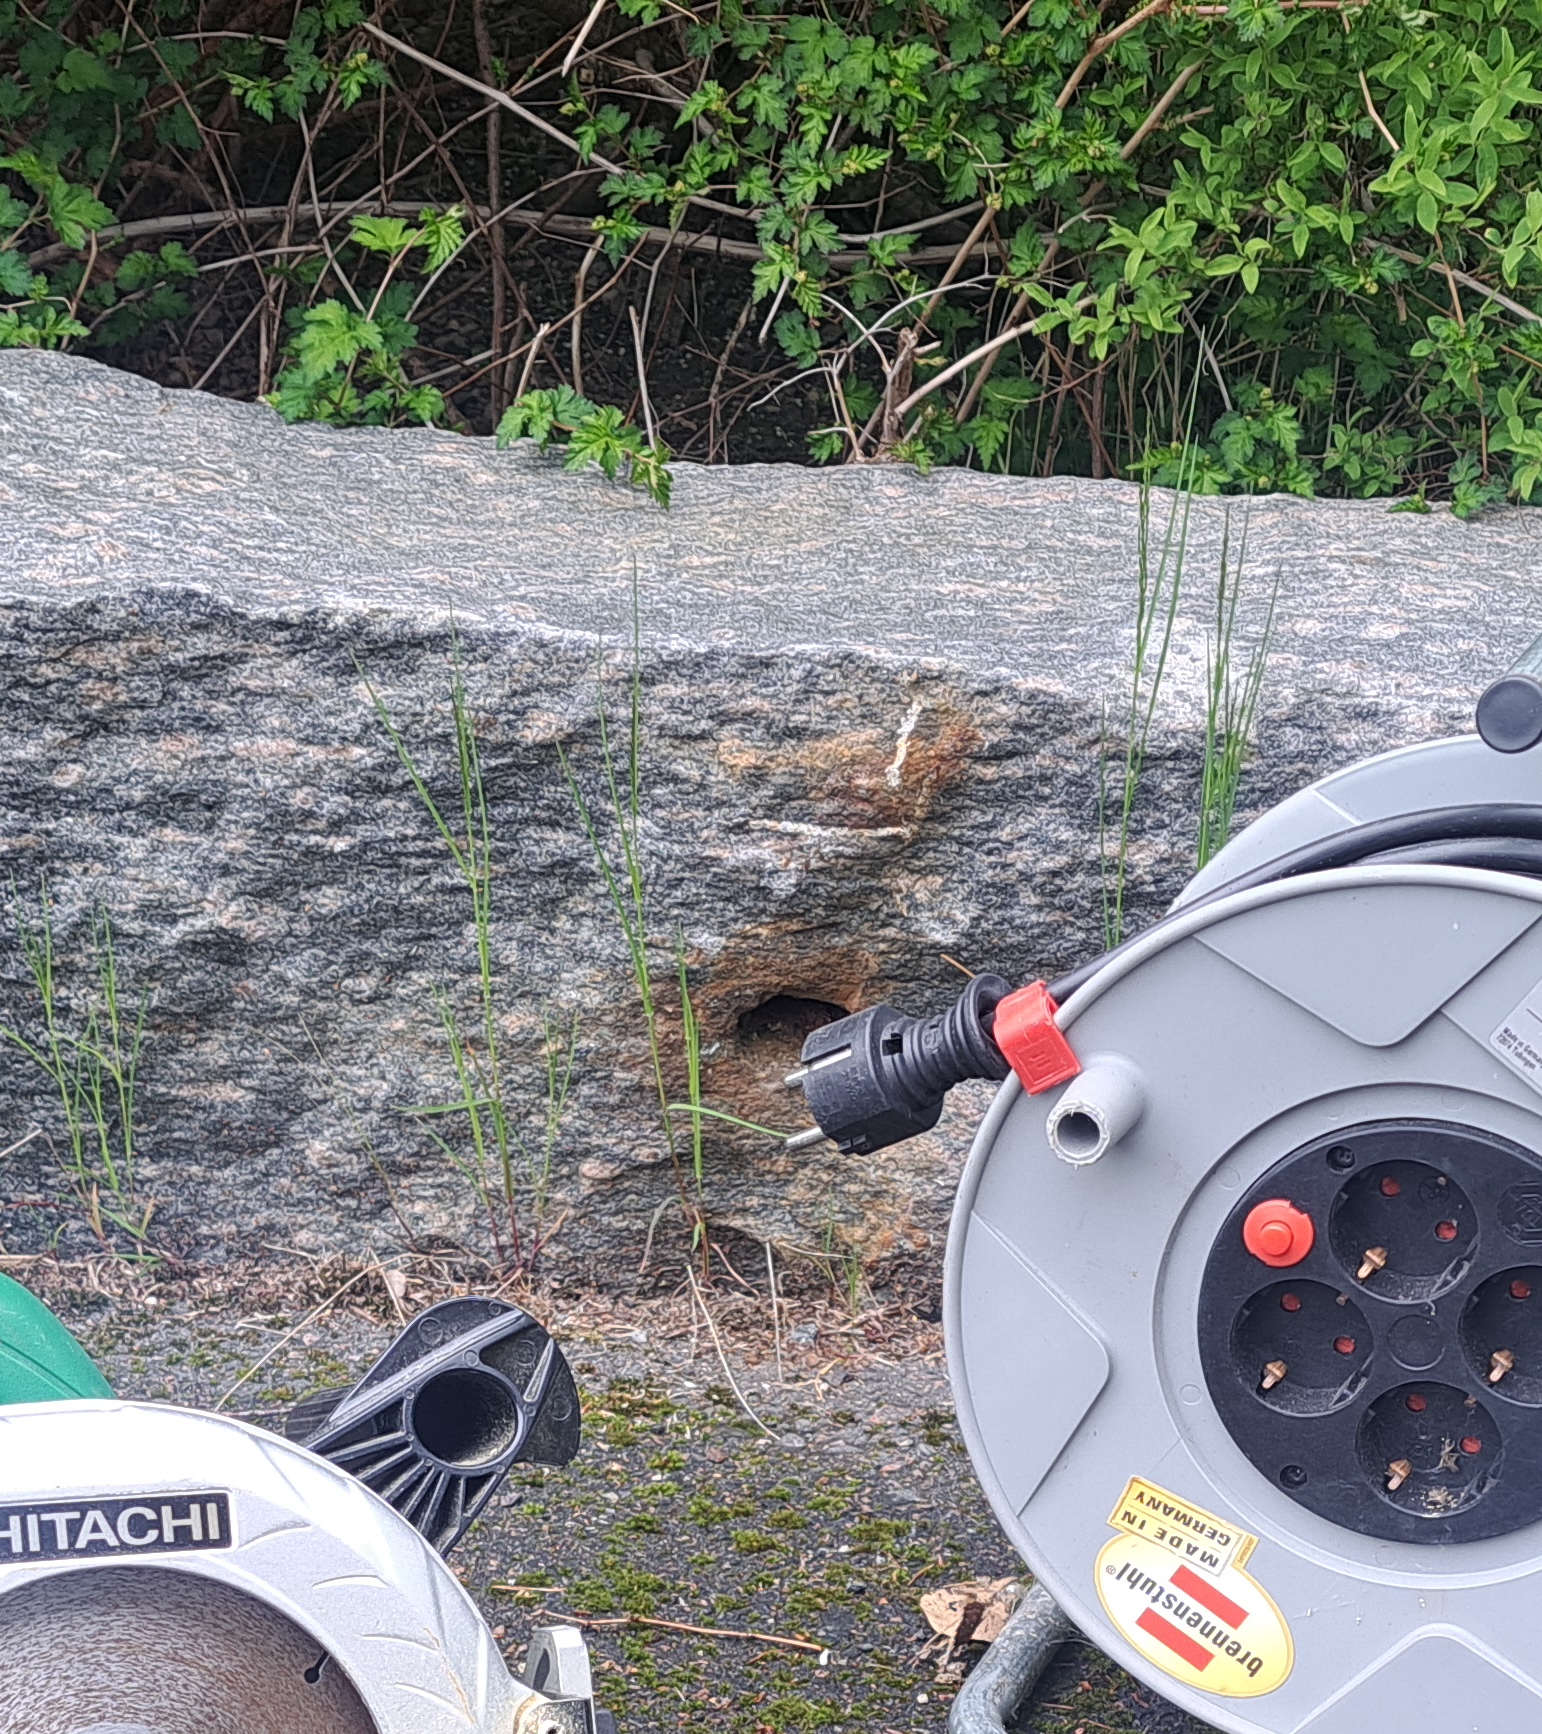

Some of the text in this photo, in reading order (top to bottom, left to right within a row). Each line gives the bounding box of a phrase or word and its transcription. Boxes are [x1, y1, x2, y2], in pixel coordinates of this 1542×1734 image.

[1120, 1510, 1147, 1531] IN
[1133, 1490, 1232, 1547] GERMANY
[1153, 1526, 1220, 1569] MADE
